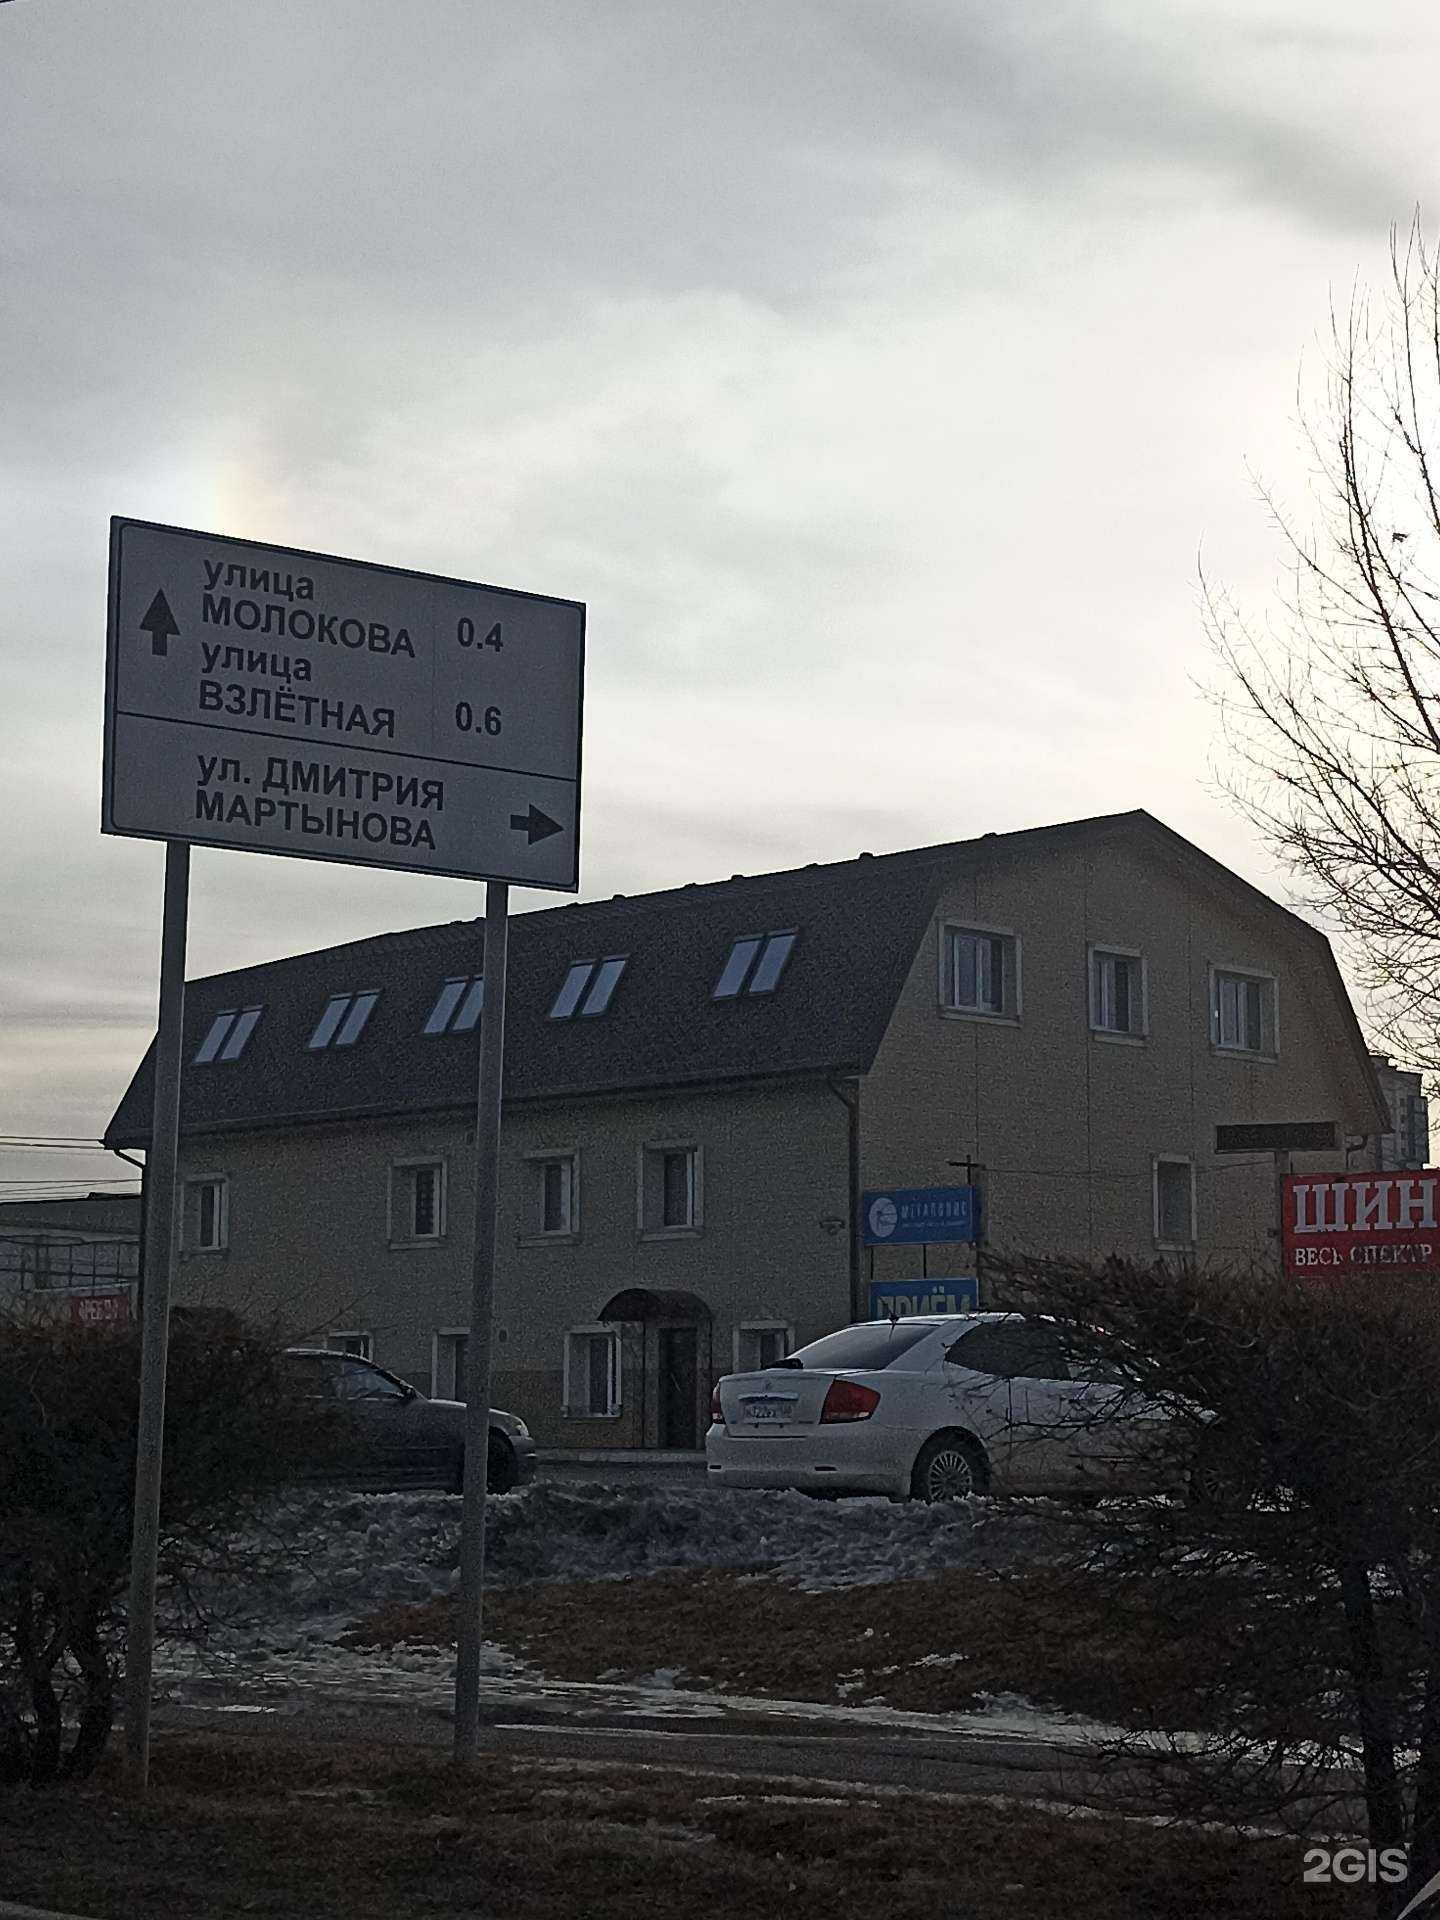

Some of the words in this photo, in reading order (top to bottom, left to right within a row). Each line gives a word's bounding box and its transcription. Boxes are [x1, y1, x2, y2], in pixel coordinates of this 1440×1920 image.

[203, 559, 314, 601] улица
[202, 594, 415, 658] МОЛОКОВА
[457, 617, 503, 652] 0.4
[201, 642, 312, 683] улица
[199, 680, 395, 738] ВЗЛЁТНАЯ
[455, 702, 502, 735] 0.6
[197, 754, 251, 786] ул.
[262, 756, 444, 811] ДМИТРИЯ
[195, 790, 436, 850] МАРТЫНОВА
[1295, 1247, 1343, 1266] ВЕСЬ
